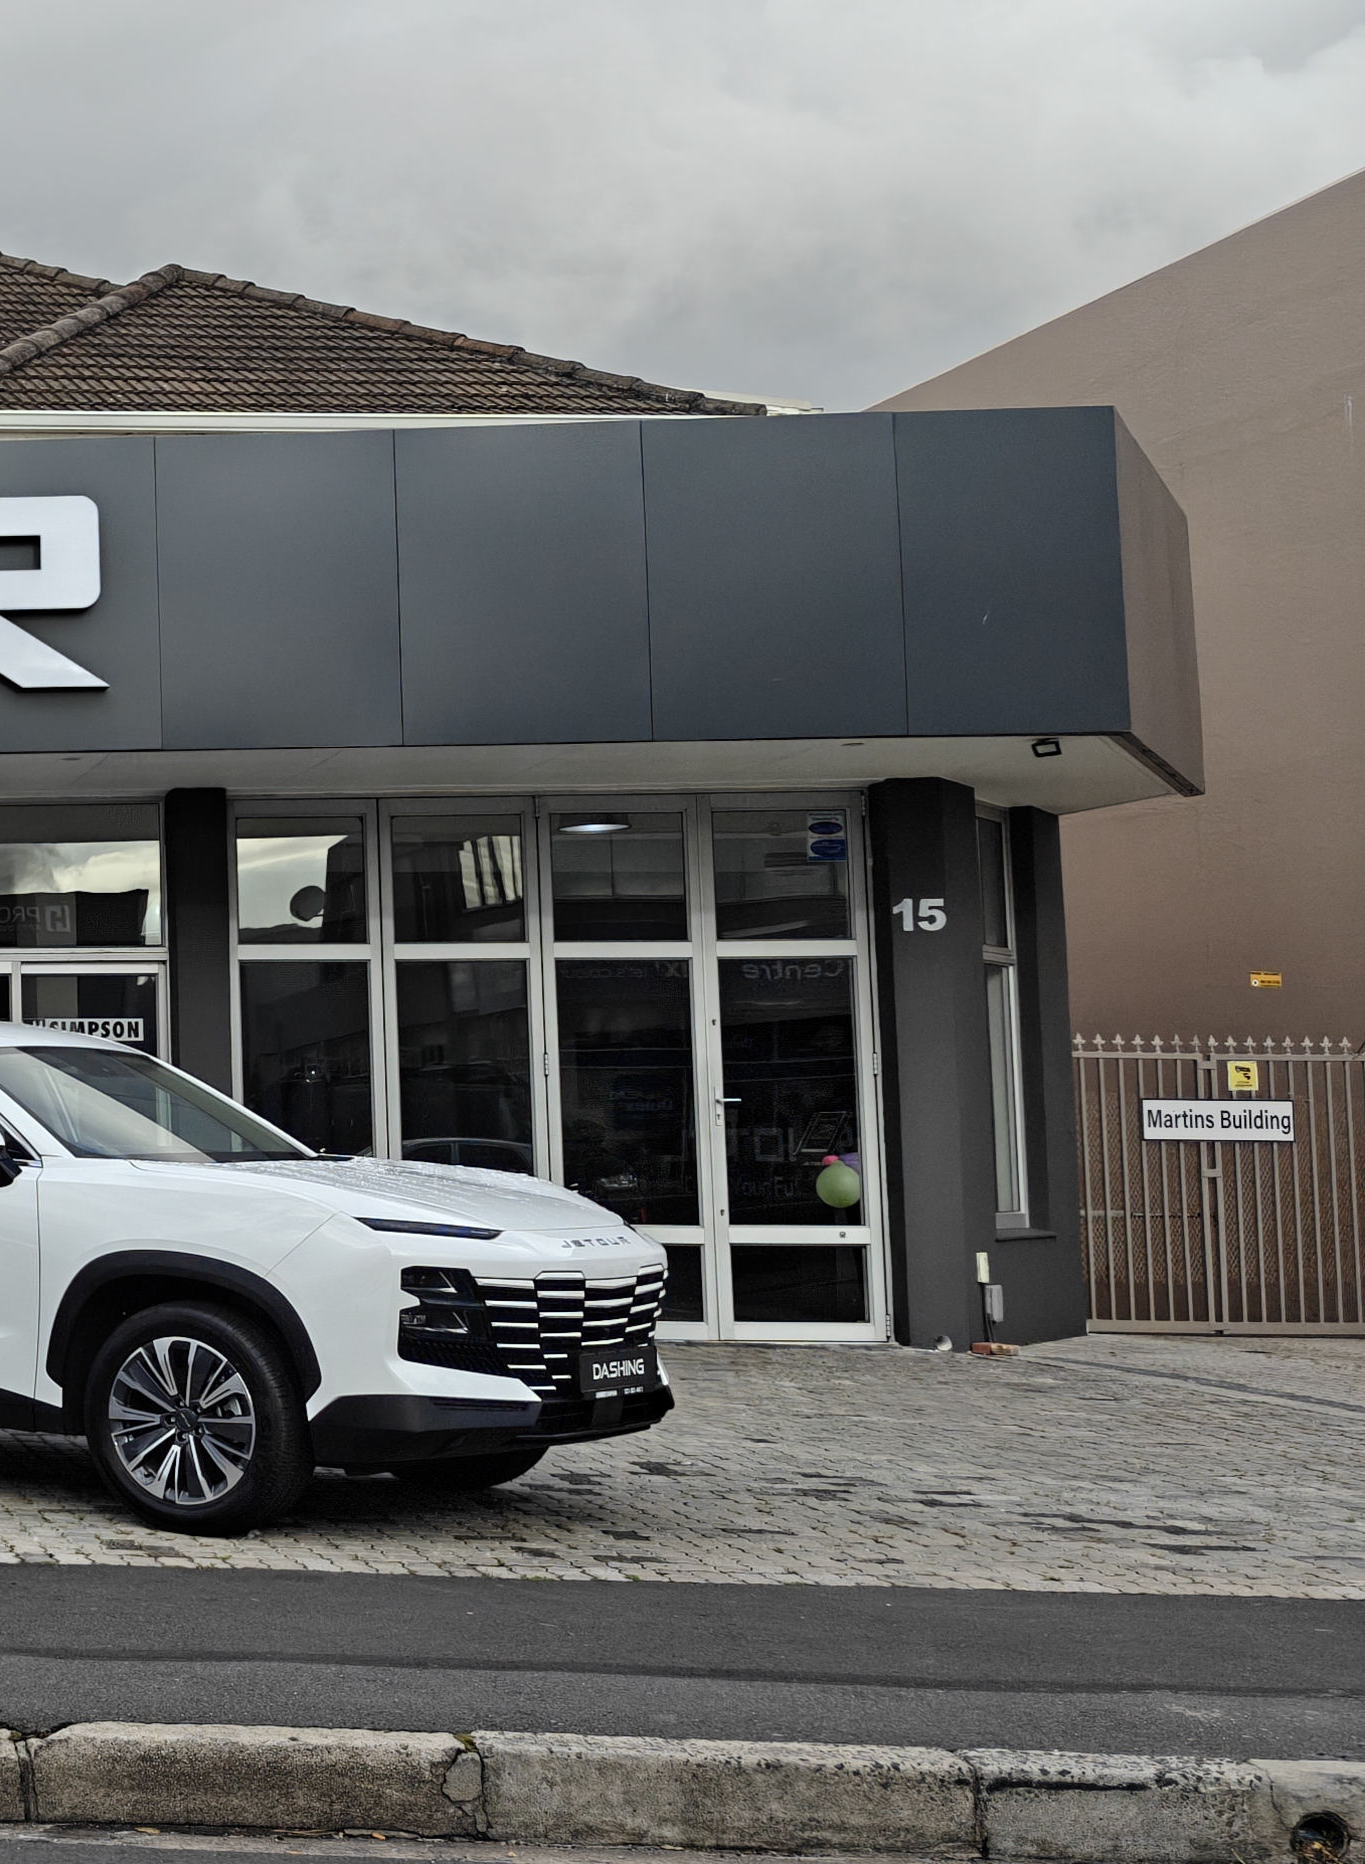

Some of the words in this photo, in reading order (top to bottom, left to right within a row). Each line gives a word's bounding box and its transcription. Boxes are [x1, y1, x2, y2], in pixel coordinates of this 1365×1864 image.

[892, 898, 947, 931] 15
[1147, 1109, 1215, 1129] Martins
[1220, 1109, 1291, 1134] Building
[561, 1236, 632, 1249] JETOUR
[592, 1358, 645, 1381] DASHING
